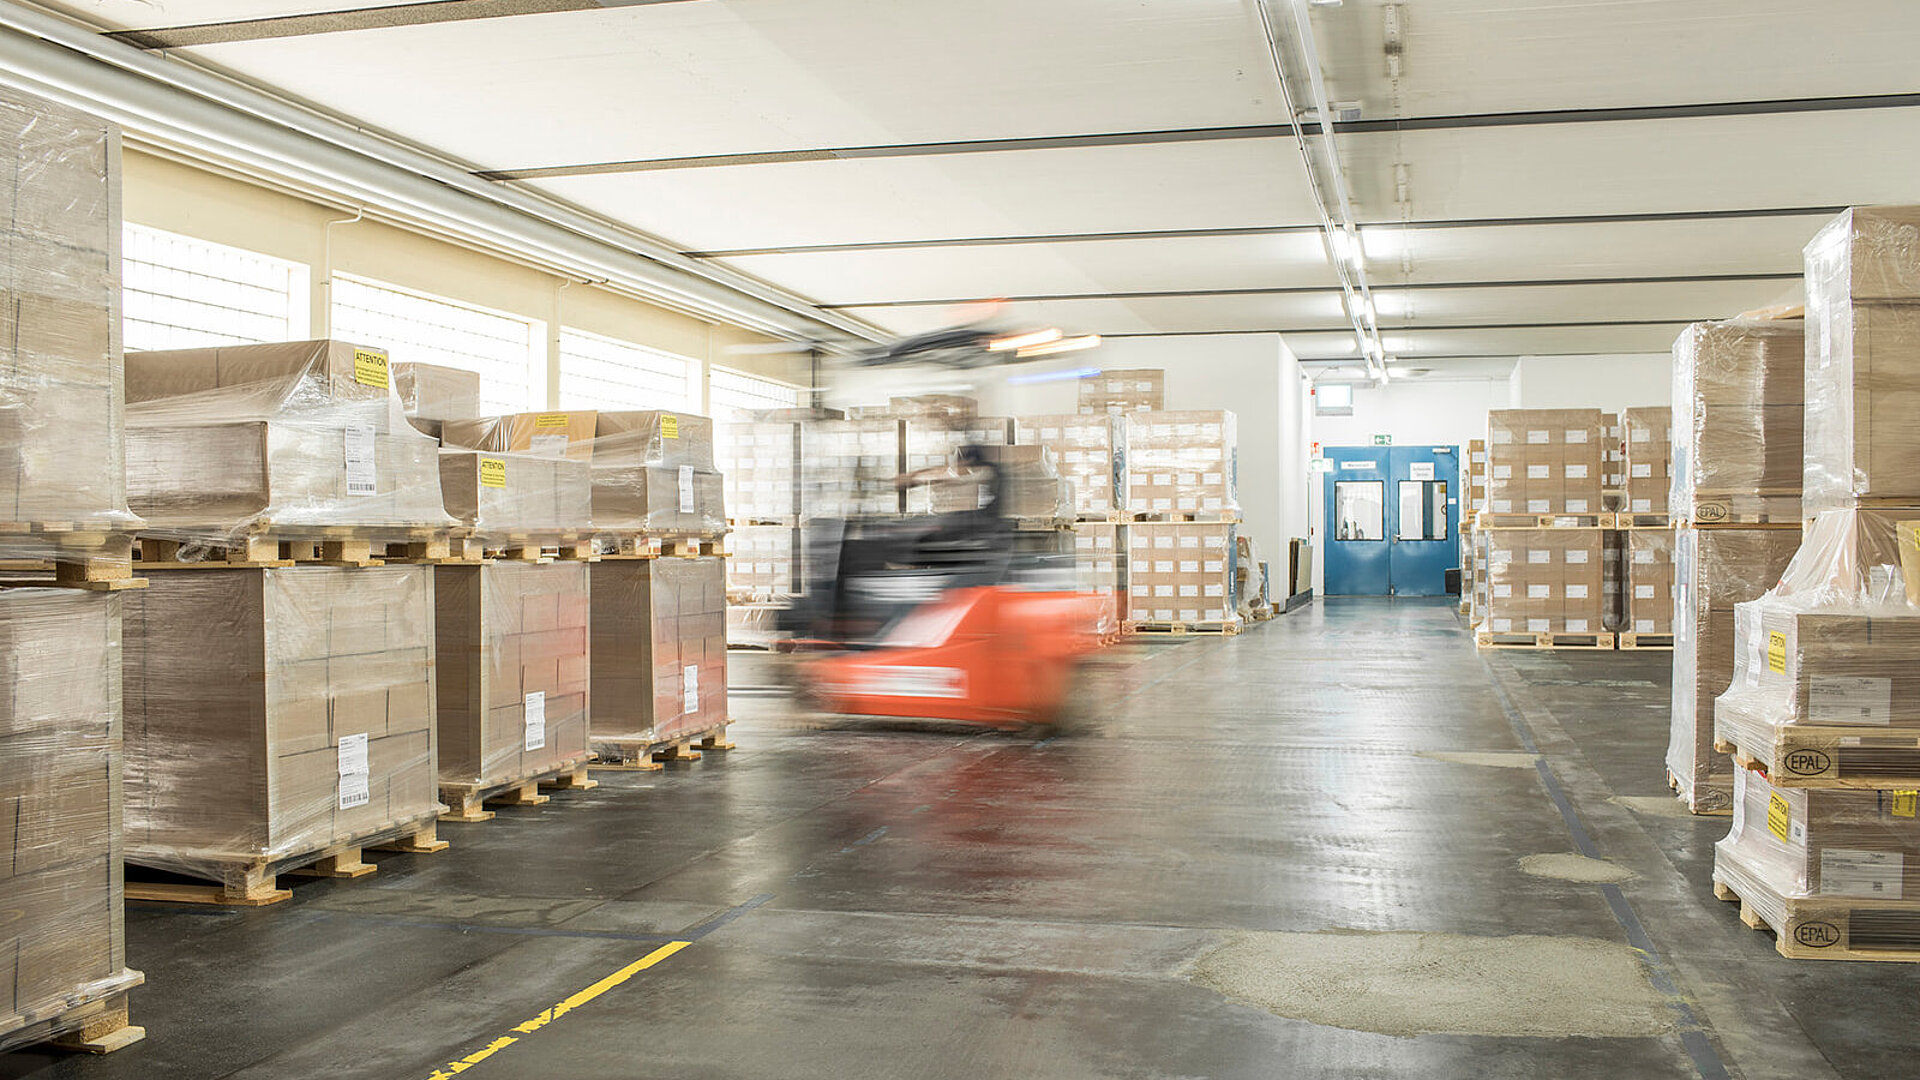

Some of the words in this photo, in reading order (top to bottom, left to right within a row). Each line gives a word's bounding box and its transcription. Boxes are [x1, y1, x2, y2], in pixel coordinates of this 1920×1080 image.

[356, 352, 386, 367] ATTENTION
[1791, 755, 1823, 770] EPAL
[1801, 927, 1833, 942] EPAL
